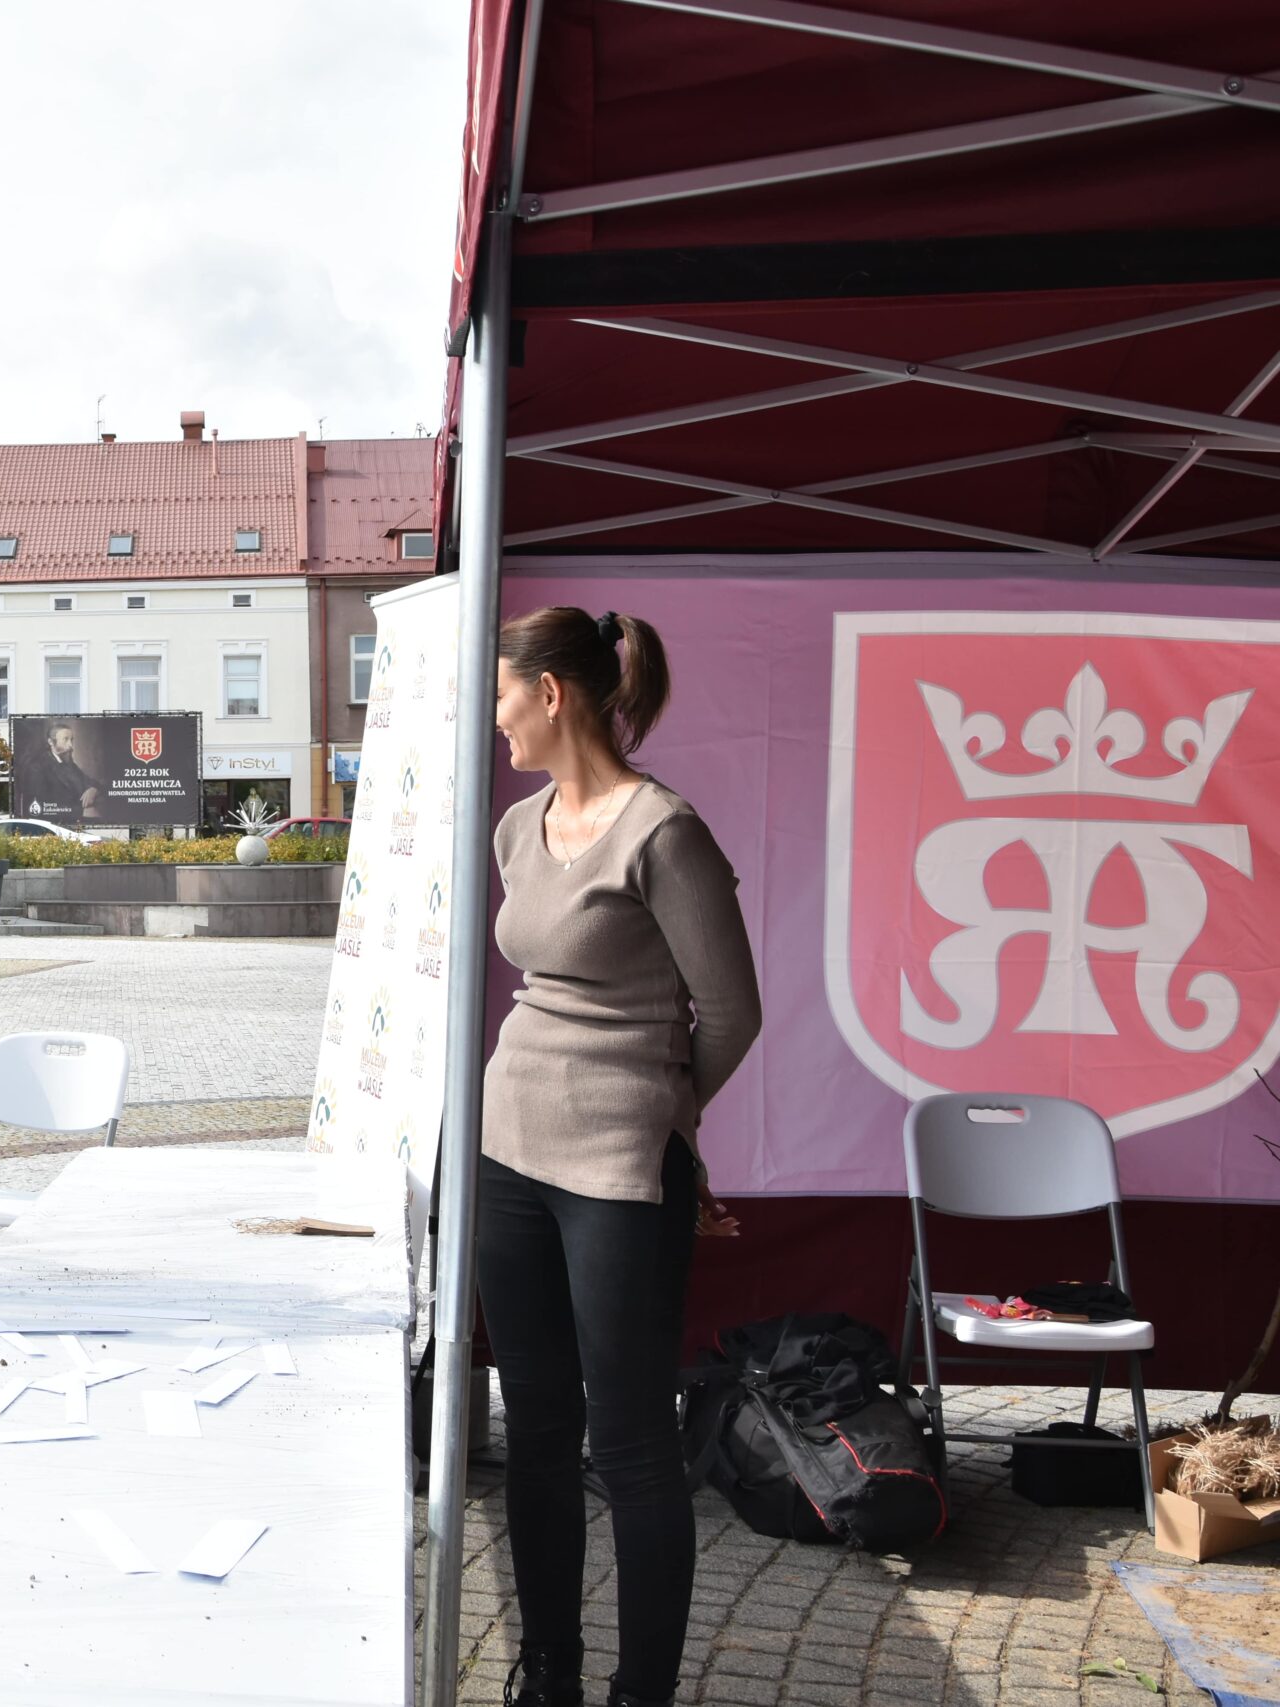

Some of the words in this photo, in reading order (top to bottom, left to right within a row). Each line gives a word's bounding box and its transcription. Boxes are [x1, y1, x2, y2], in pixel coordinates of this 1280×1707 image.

[124, 768, 148, 777] 2022
[149, 768, 170, 777] ROK
[112, 779, 182, 788] ŁUKASIEWICZA
